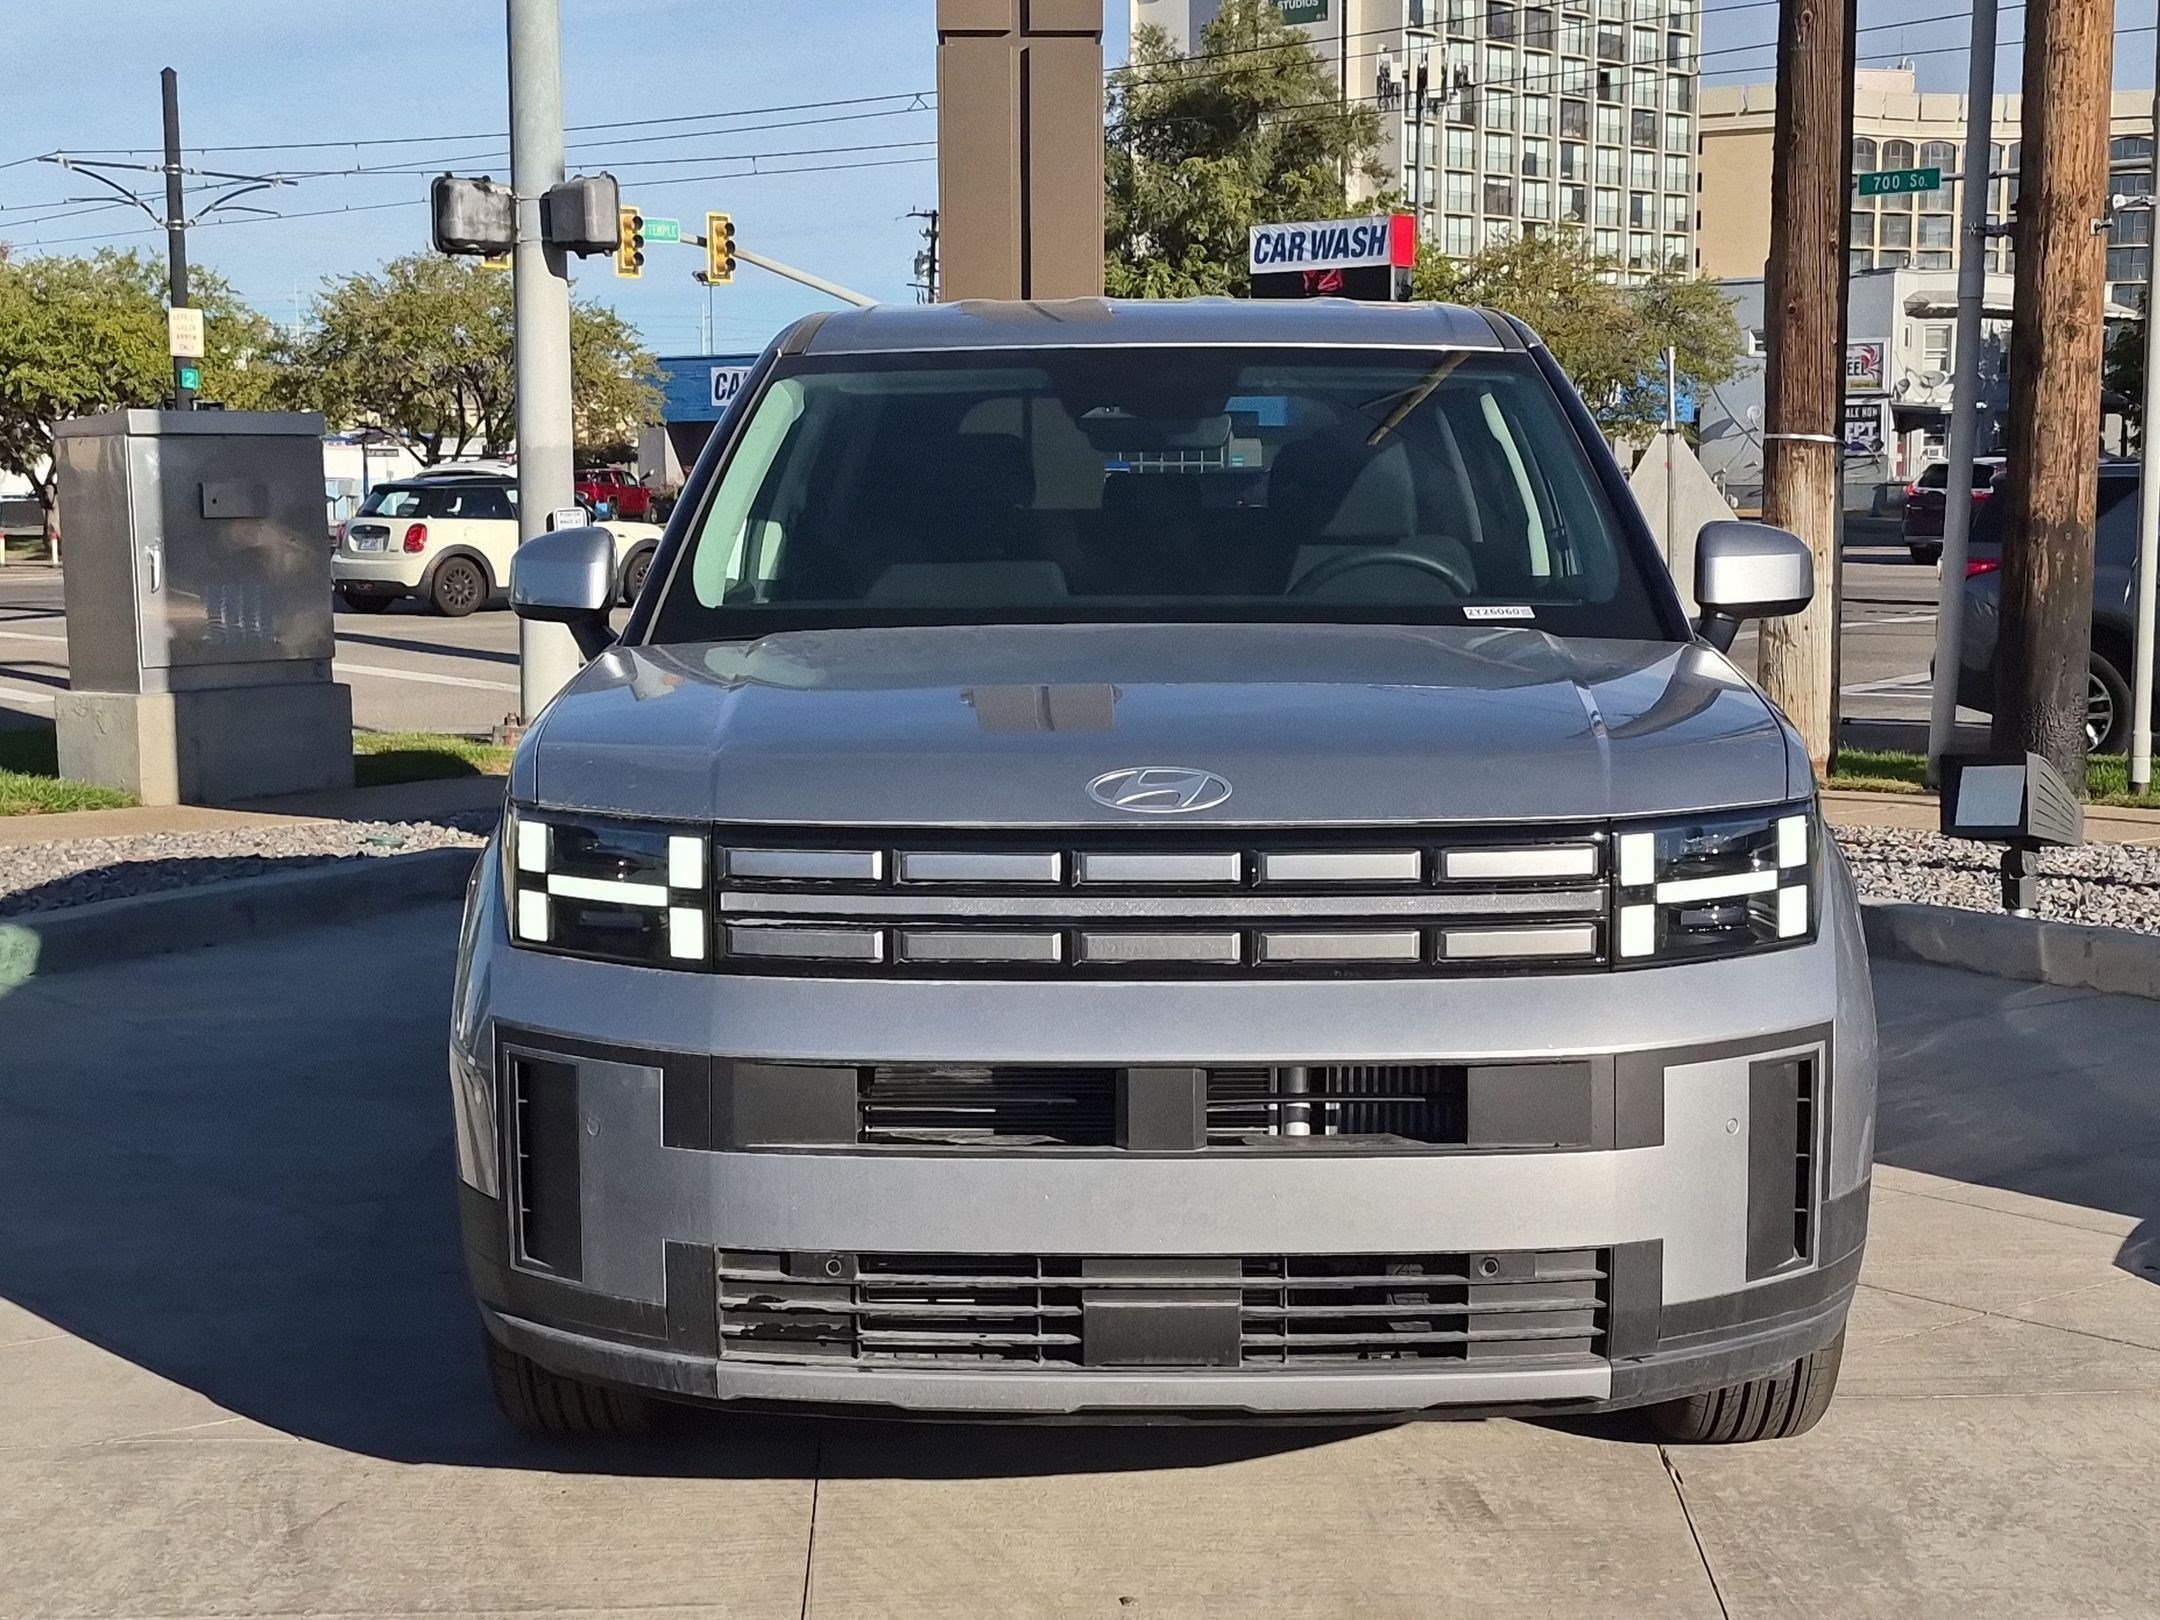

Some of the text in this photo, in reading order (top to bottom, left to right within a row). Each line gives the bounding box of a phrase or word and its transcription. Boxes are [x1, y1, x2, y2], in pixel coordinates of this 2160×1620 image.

[1873, 175, 1900, 191] 700
[647, 223, 677, 238] TEMPLE
[1253, 223, 1388, 265] CAR WASH
[184, 371, 196, 389] 2
[715, 372, 748, 401] CA
